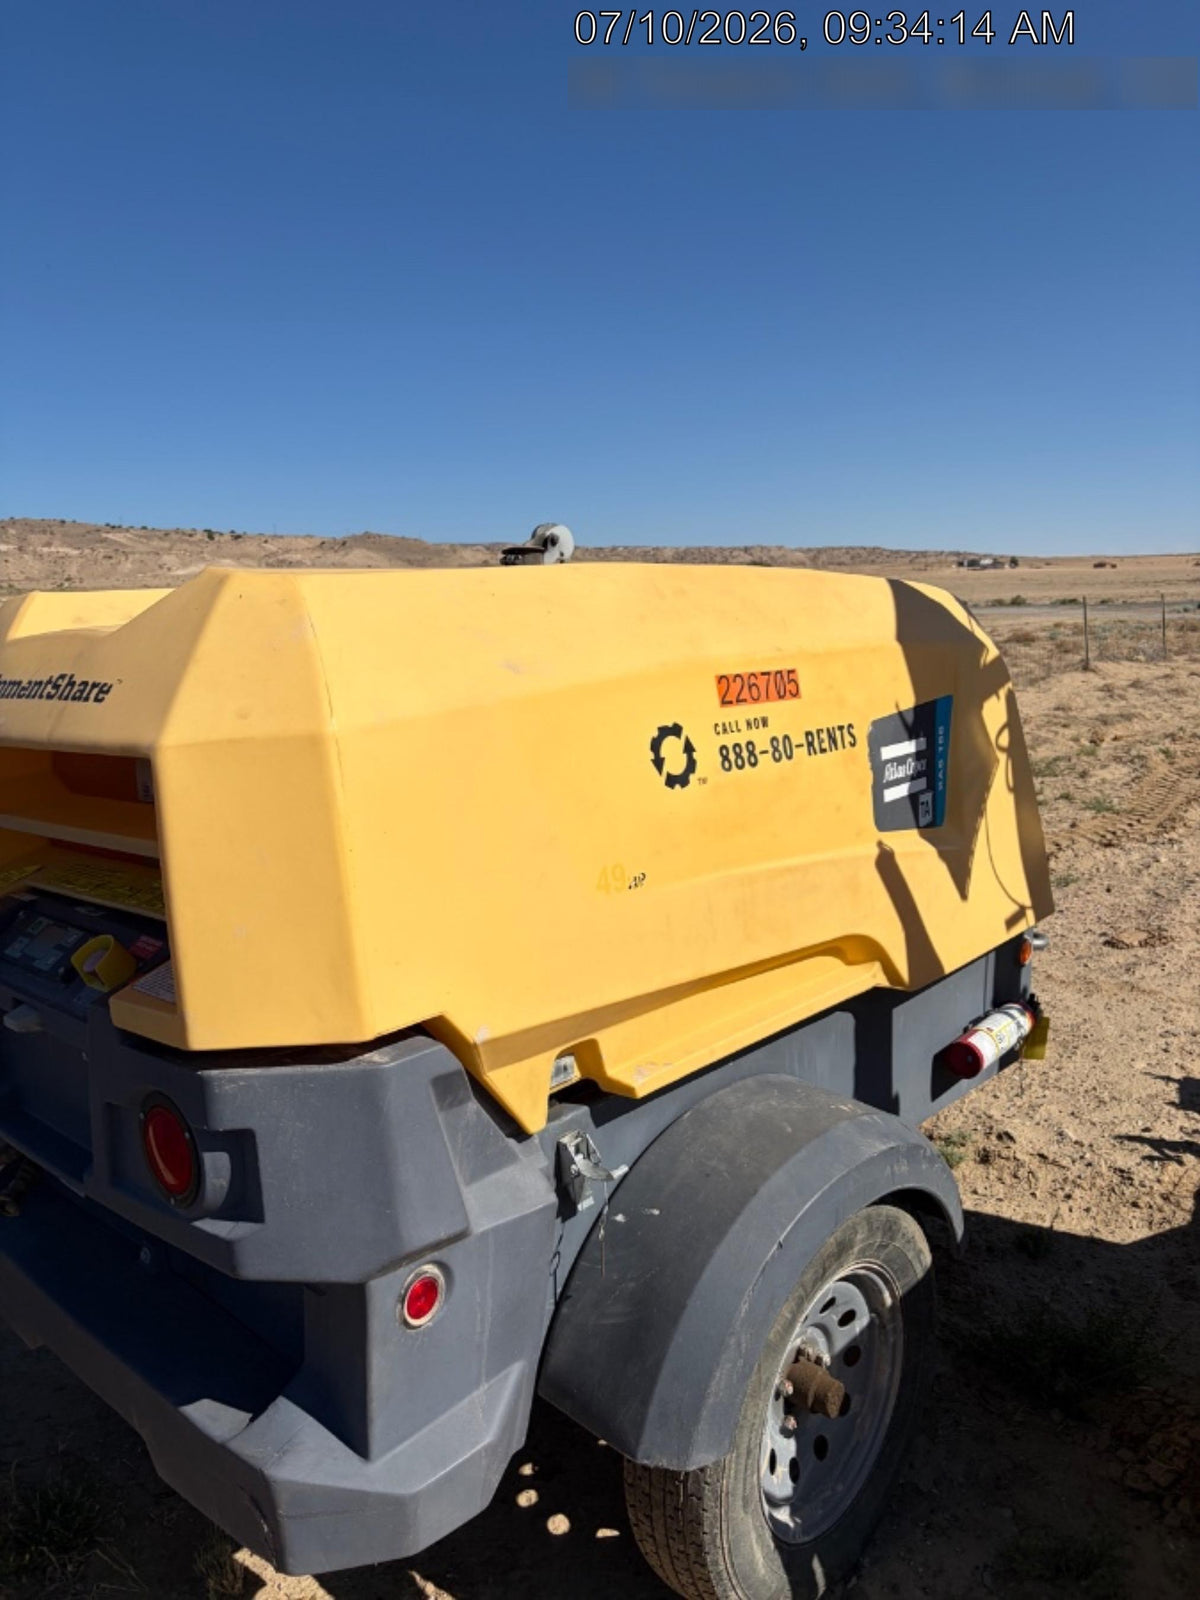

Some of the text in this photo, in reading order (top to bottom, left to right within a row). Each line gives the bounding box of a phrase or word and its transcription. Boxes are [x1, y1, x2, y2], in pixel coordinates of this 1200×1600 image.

[717, 668, 801, 706] 226705
[714, 715, 769, 736] CALL NOW
[718, 722, 858, 773] 888-80-RENTS
